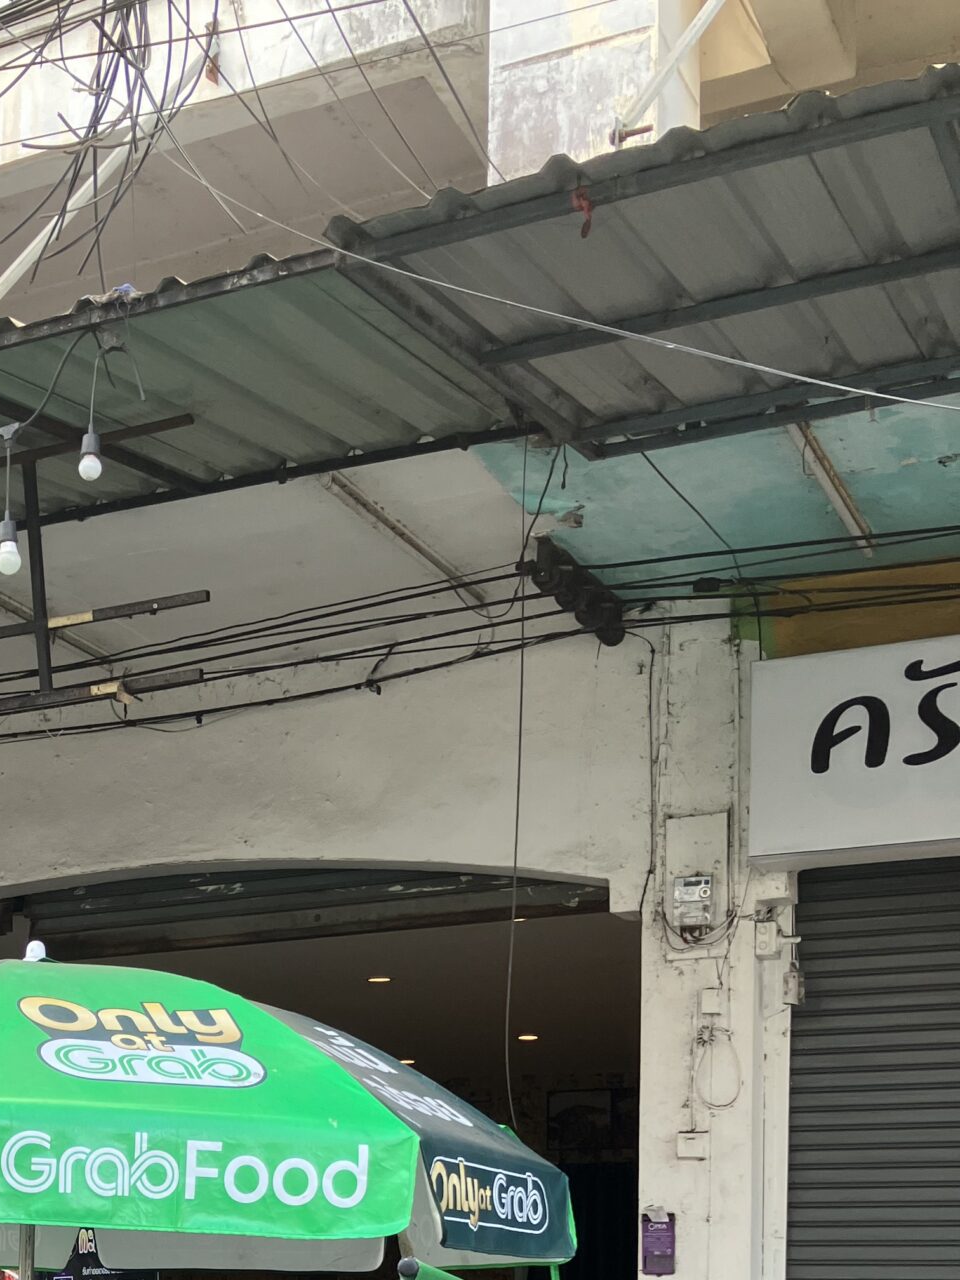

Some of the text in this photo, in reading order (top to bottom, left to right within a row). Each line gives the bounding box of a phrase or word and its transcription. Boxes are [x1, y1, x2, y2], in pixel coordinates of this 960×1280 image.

[20, 997, 241, 1044] Only
[111, 1030, 174, 1053] at
[54, 1044, 258, 1087] Grab
[1, 1130, 369, 1209] GrabFood
[431, 1161, 542, 1227] Only at Grab
